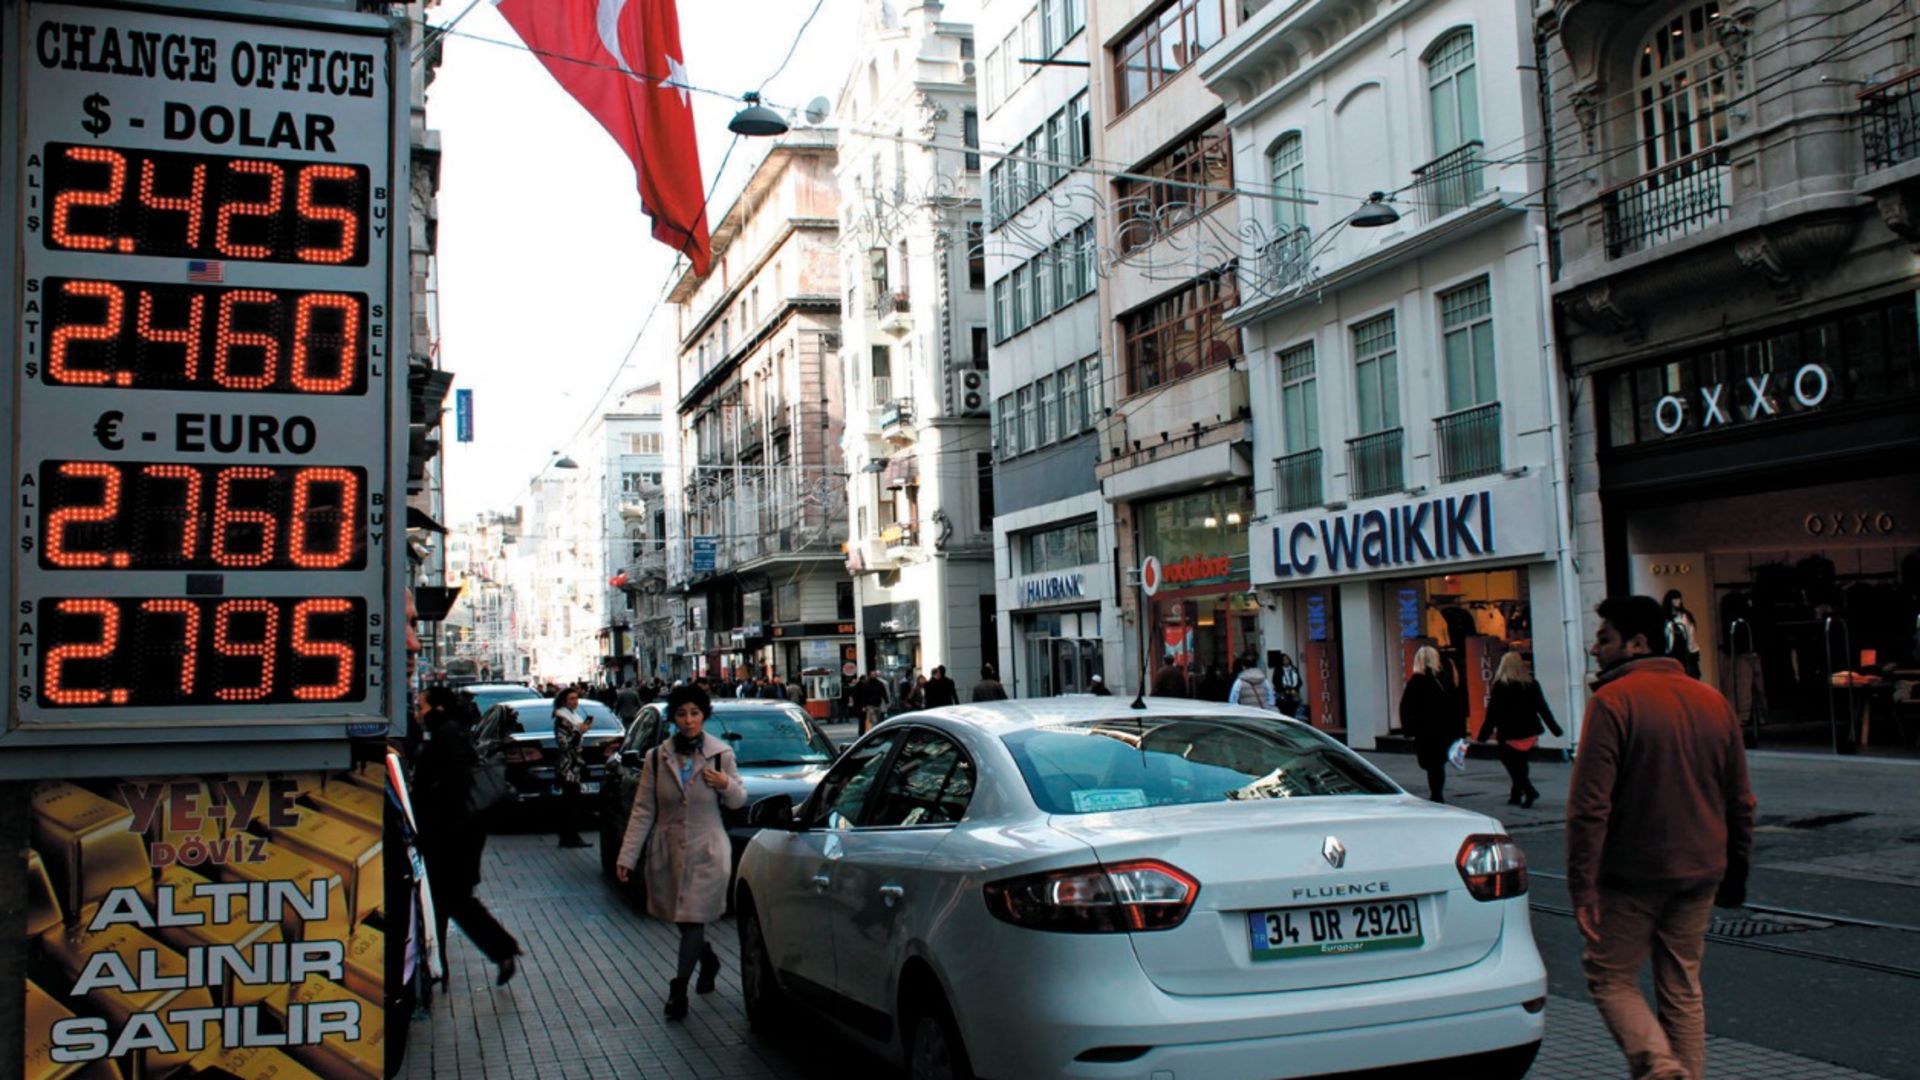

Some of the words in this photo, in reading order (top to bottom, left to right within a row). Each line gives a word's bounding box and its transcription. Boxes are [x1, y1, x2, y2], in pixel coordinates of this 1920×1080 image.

[36, 20, 217, 83] CHANGE
[231, 41, 375, 98] OFFICE
[81, 92, 112, 138] $
[163, 101, 337, 153] DOLAR
[26, 153, 42, 233] ALIŞ
[52, 147, 358, 263] 2.425
[373, 186, 387, 239] BUY
[24, 279, 40, 378] SATIŞ
[49, 281, 360, 392] 2.460
[371, 304, 384, 377] SELL
[1656, 363, 1828, 434] OXXO
[93, 410, 125, 451] €
[175, 412, 317, 454] EURO
[20, 473, 36, 553] ALIŞ
[46, 462, 358, 568] 2.760
[370, 493, 384, 545] BUY
[1804, 511, 1895, 536] OXXO
[1162, 552, 1231, 583] vodafone
[1272, 521, 1317, 577] LC
[1026, 573, 1082, 603] HALKBANK
[18, 600, 34, 702] SATIŞ
[44, 598, 355, 704] 2.795
[369, 613, 383, 687] SELL
[117, 779, 301, 834] YE-YE
[151, 834, 268, 867] DÖVİZ
[88, 878, 329, 932] ALTIN
[1291, 881, 1392, 900] FLUENCE
[1265, 912, 1300, 945] 34
[1309, 908, 1343, 941] DR
[1352, 903, 1413, 938] 2920
[1320, 943, 1365, 953] Europcar
[69, 939, 345, 997] ALINIR
[50, 999, 361, 1063] SATILIR
